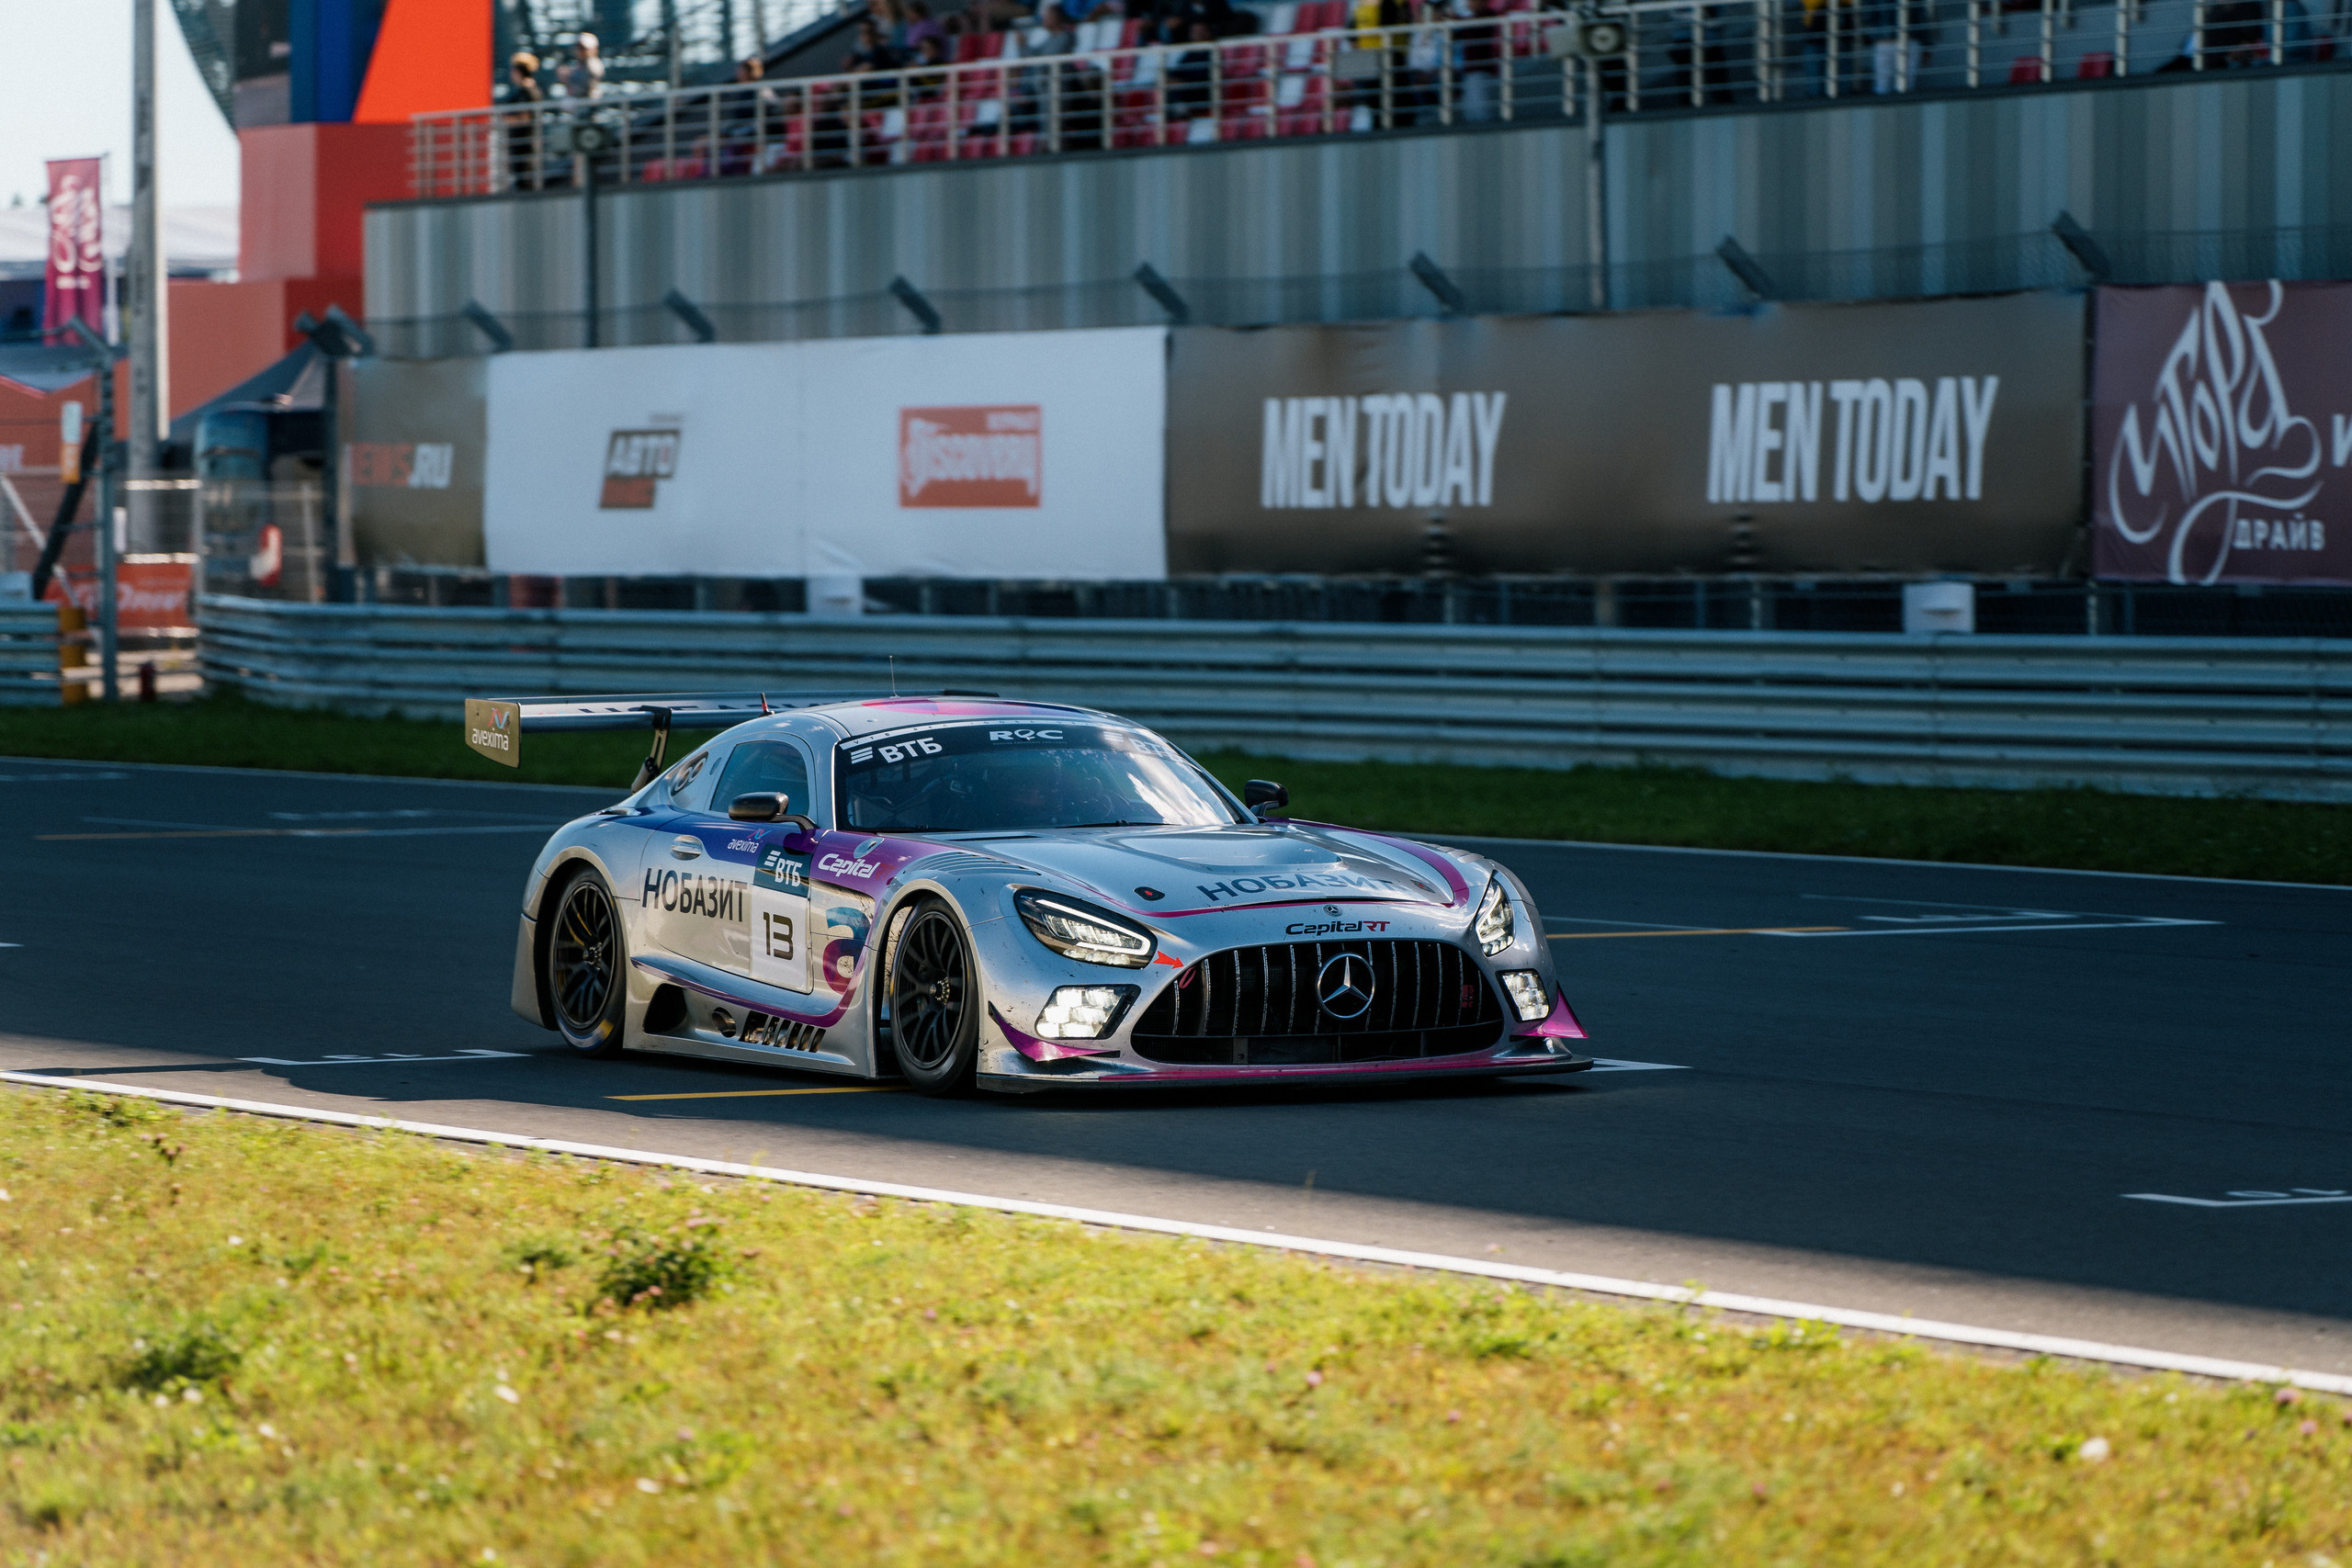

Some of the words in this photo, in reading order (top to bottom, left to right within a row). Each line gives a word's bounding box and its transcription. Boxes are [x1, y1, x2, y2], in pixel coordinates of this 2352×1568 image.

[1261, 397, 1357, 509] MEN
[1362, 391, 1508, 508] TODAY
[1708, 380, 1823, 503] MEN
[1829, 375, 2000, 502] TODAY
[2233, 512, 2326, 551] ДРАЙВ
[471, 727, 509, 751] avexima
[877, 737, 943, 763] ВТБ
[727, 838, 760, 853] avexima
[775, 857, 803, 887] ВТБ
[641, 867, 748, 922] НОБАЗИТ
[1196, 873, 1400, 902] НОБАЗИТ
[763, 911, 794, 961] 13
[1286, 920, 1390, 936] CapitalRT
